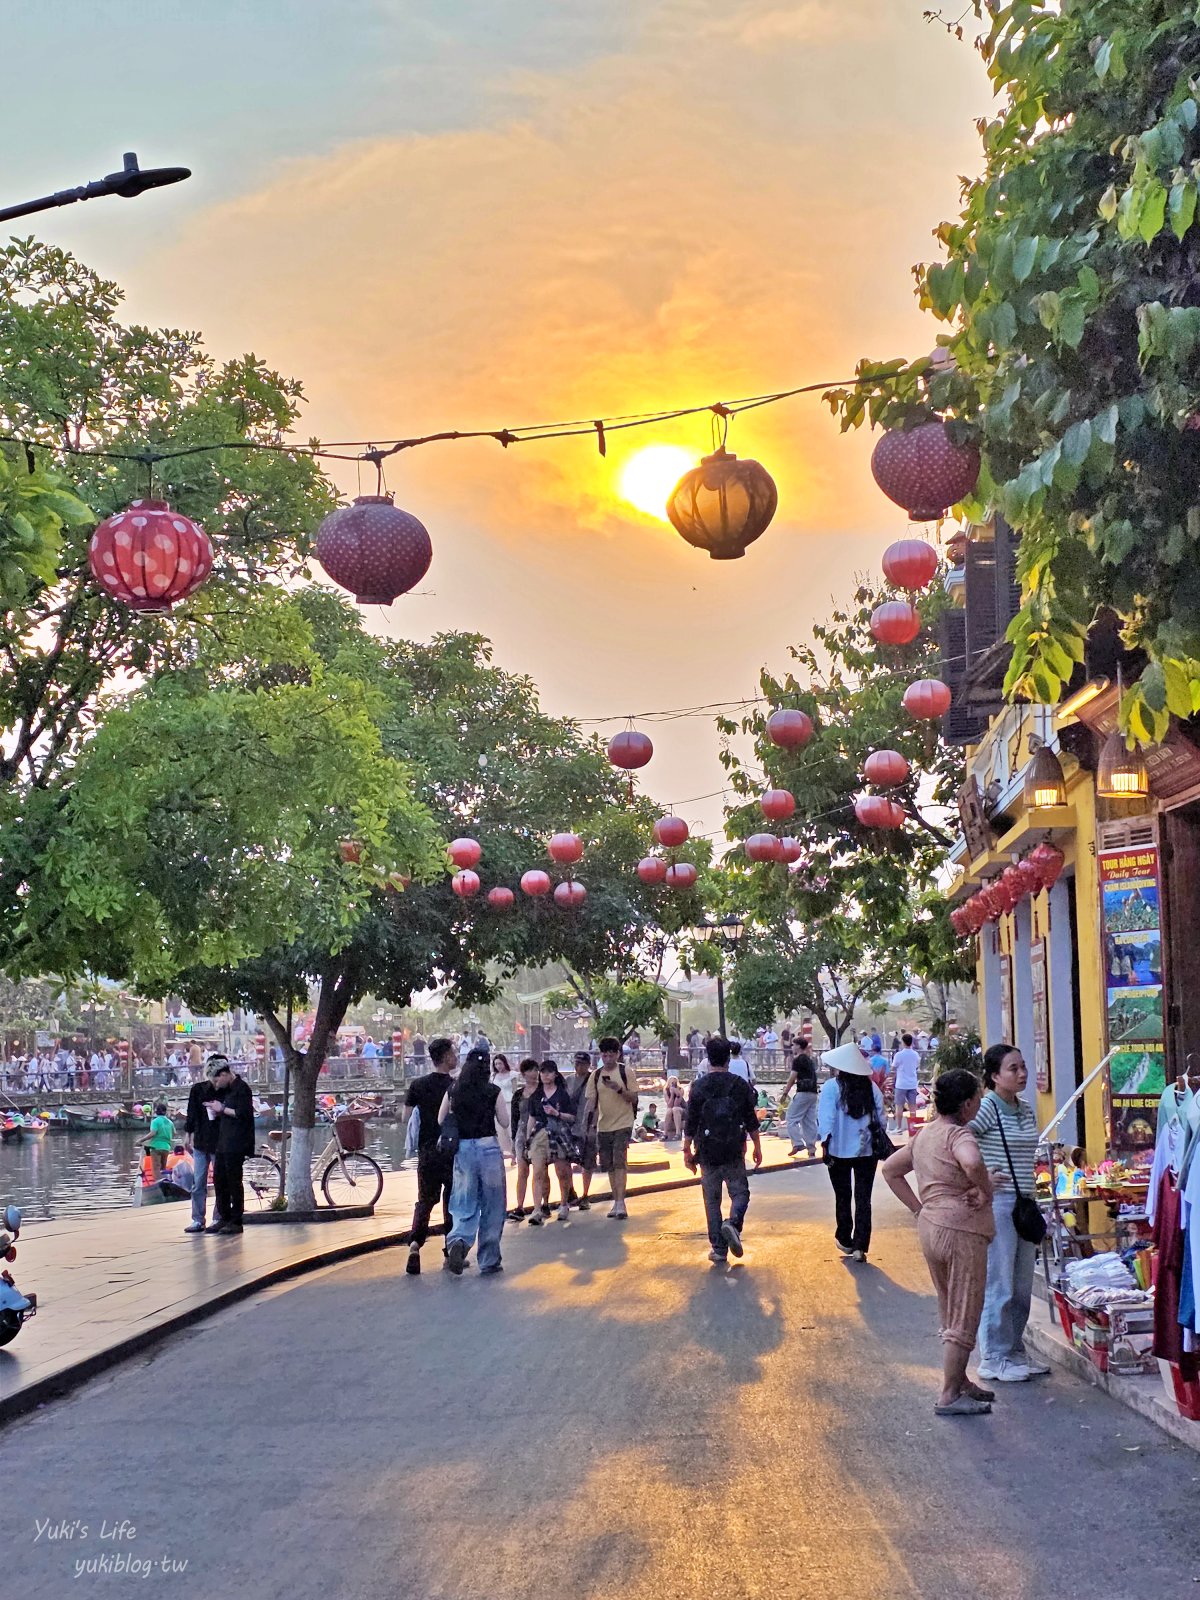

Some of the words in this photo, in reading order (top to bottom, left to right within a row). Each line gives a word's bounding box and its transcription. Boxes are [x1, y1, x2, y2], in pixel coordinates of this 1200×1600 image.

[1102, 859, 1118, 870] TOUR
[1107, 869, 1129, 879] Daily
[1132, 868, 1151, 876] Tour
